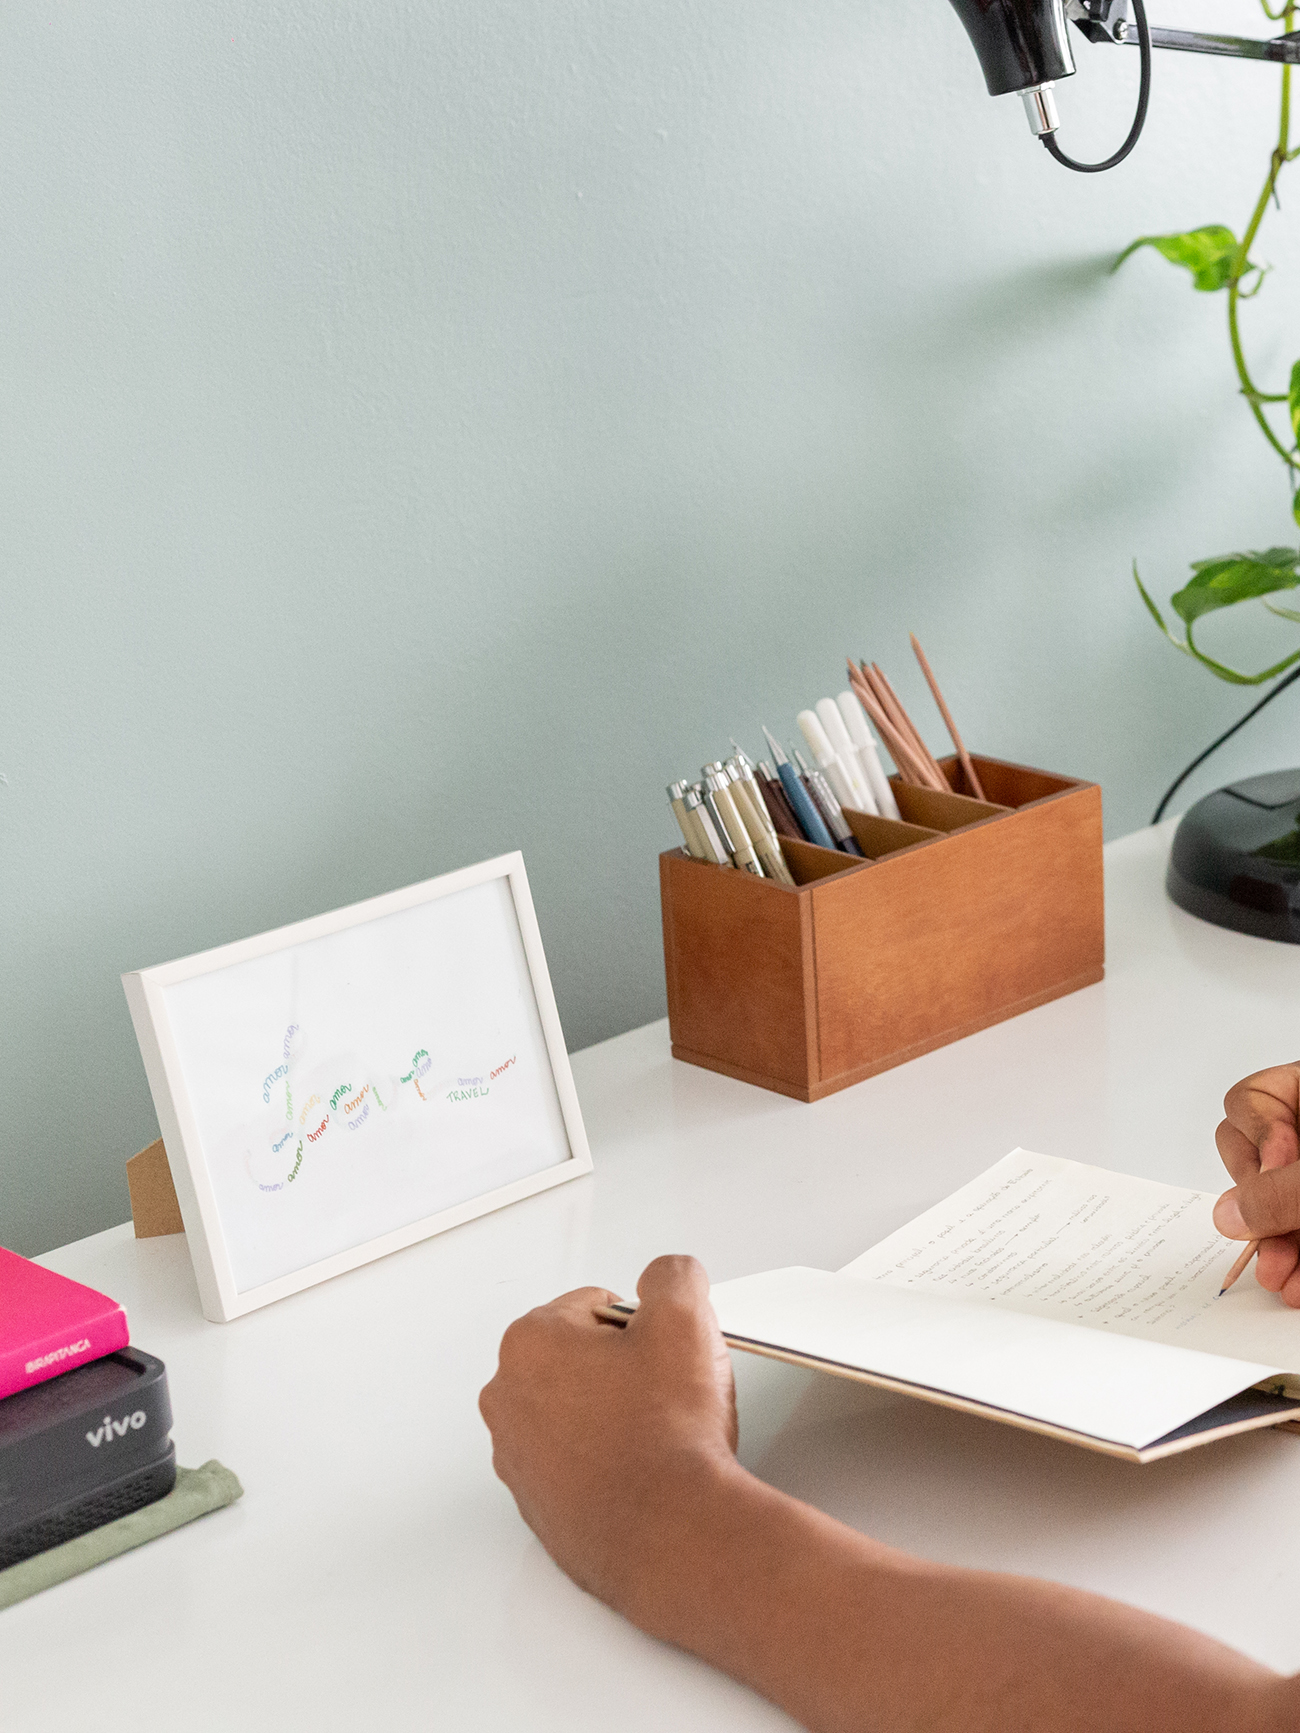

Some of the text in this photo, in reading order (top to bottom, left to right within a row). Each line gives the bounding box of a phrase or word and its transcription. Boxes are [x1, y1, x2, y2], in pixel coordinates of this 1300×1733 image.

[490, 1056, 516, 1080] amor
[263, 1064, 288, 1103] amor
[330, 1083, 352, 1110] amor
[446, 1087, 490, 1102] TRAVEL
[344, 1084, 370, 1114] amor
[307, 1114, 330, 1142] amor
[288, 1140, 303, 1182] amor
[86, 1411, 146, 1447] vivo
